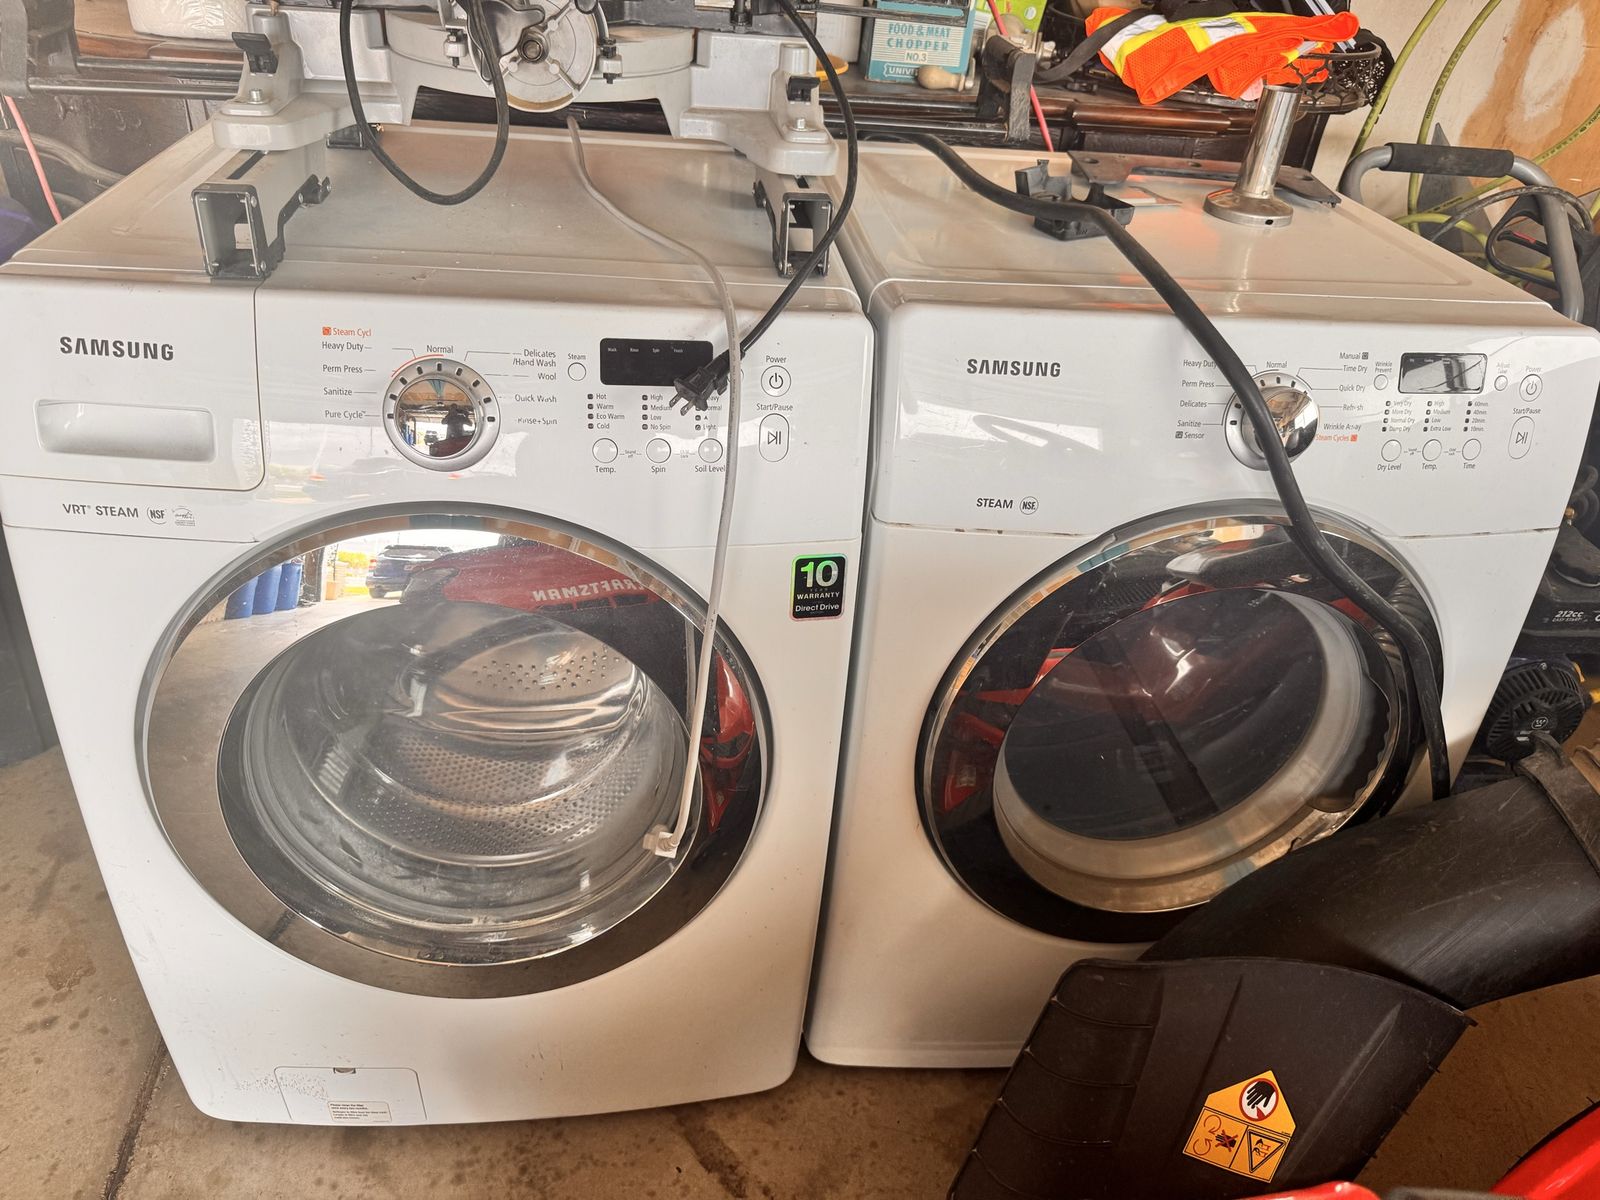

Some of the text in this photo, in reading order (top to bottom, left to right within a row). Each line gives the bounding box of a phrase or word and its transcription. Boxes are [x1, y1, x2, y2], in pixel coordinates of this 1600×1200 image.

[888, 23, 951, 38] FOOD & MEAT
[887, 38, 949, 52] CHOPPER
[906, 53, 927, 61] NO.3
[333, 327, 355, 337] Steam
[59, 336, 174, 361] SAMSUNG
[322, 341, 364, 352] Heavy Duty
[426, 345, 454, 354] Normal
[523, 349, 556, 358] Delicates
[512, 358, 556, 368] /Hand Wash
[967, 358, 1061, 377] SAMSUNG
[1183, 359, 1217, 369] Heavy Duty
[1266, 361, 1288, 369] Normal
[322, 364, 364, 373] Perm Press
[1357, 365, 1368, 373] Dry
[537, 372, 557, 380] Wool
[1199, 380, 1215, 388] Press
[1339, 384, 1366, 393] Quick Dry
[323, 387, 353, 396] Sanitize
[514, 393, 535, 403] Quick
[756, 403, 794, 412] Start/Pause
[1180, 400, 1208, 408] Delicates
[325, 409, 340, 418] Pure
[1513, 407, 1541, 415] Start/Pause
[595, 465, 616, 473] Temp.
[651, 465, 666, 473] Spin
[694, 465, 726, 473] Soil Level
[1377, 464, 1387, 472] Dry
[1422, 463, 1437, 471] Temp.
[1463, 462, 1476, 470] Time
[976, 498, 1013, 509] STEAM
[95, 505, 139, 518] STEAM
[149, 508, 166, 519] NSF
[801, 560, 839, 588] 10
[796, 591, 840, 600] WARRANTY
[795, 604, 819, 612] Direct
[820, 603, 840, 611] Drive
[1555, 610, 1584, 618] 212cc
